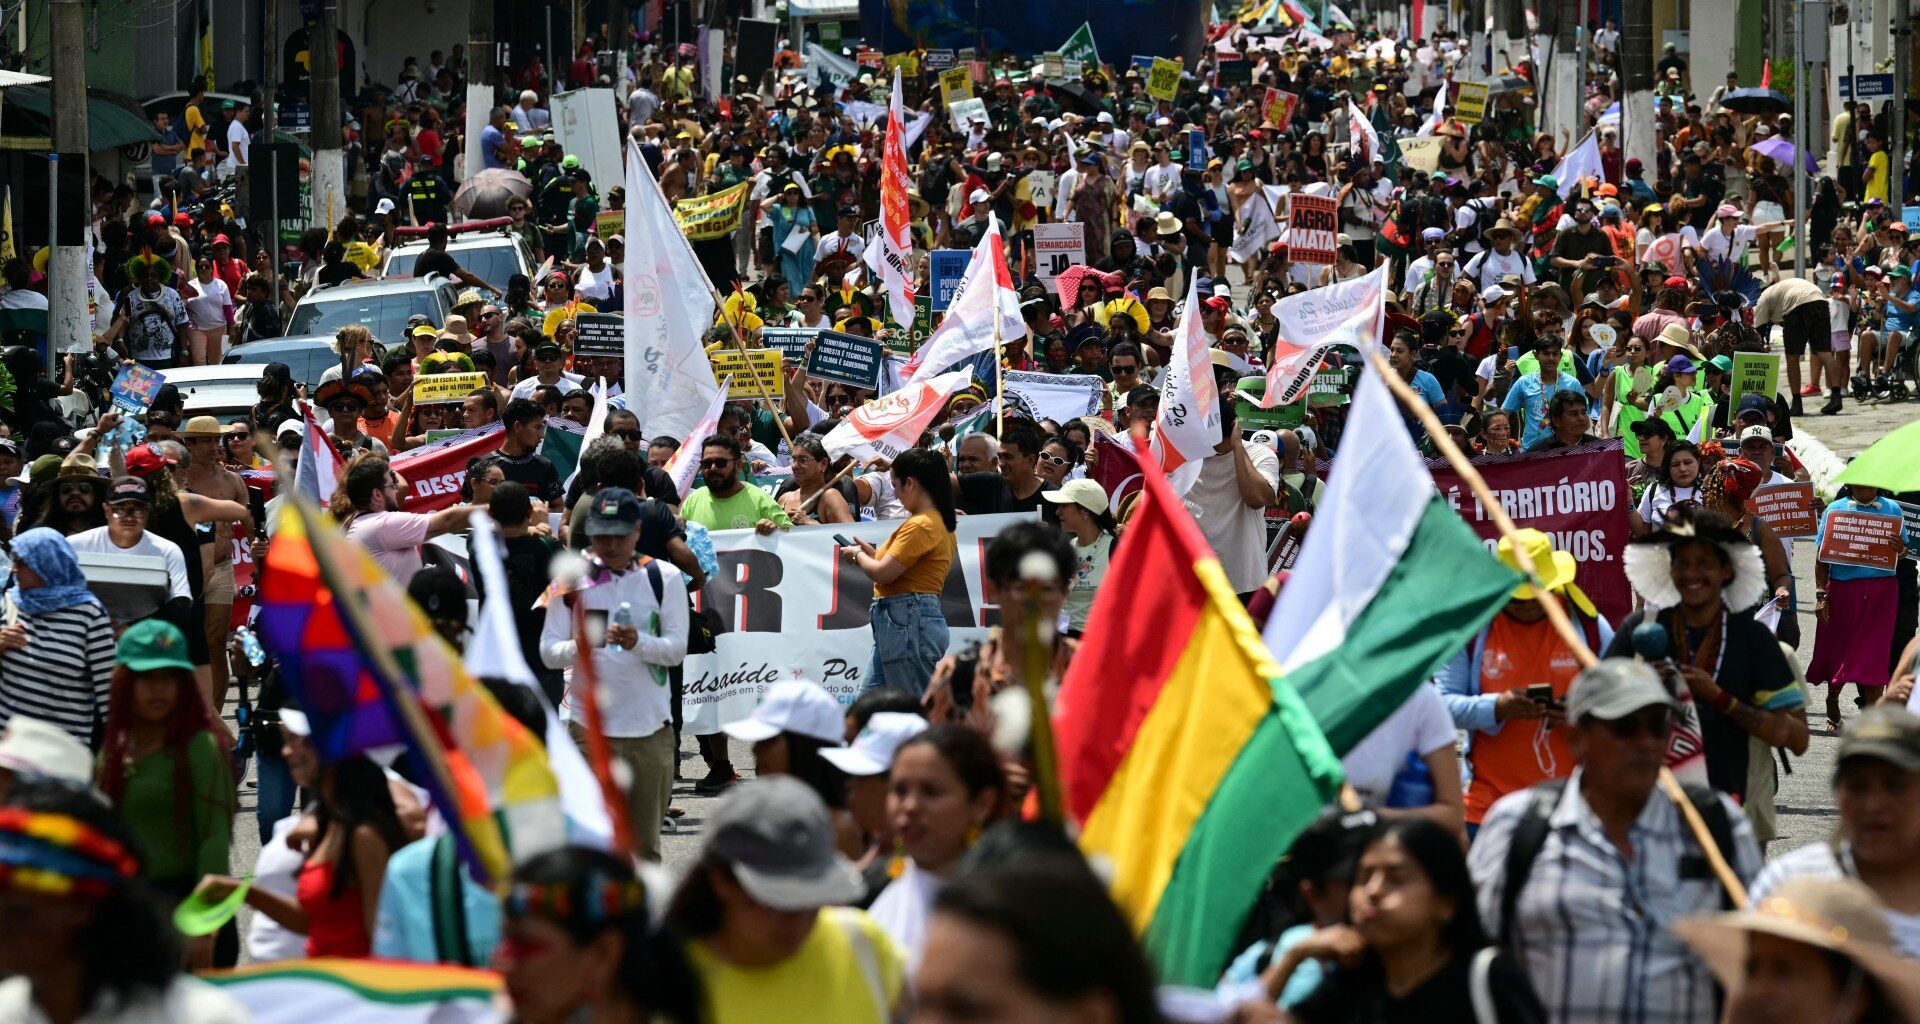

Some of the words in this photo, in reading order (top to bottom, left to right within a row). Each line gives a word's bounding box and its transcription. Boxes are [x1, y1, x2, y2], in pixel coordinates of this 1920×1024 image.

[1292, 208, 1335, 231] AGRO
[600, 222, 622, 231] poder
[1036, 241, 1082, 249] DEMARCAÇÃO
[1290, 228, 1336, 251] MATA
[941, 290, 950, 301] DE
[824, 338, 849, 349] TERRITÓRIO
[818, 347, 840, 357] FLORESTA
[823, 355, 837, 365] CLIMA
[1281, 367, 1311, 402] direitos
[1742, 379, 1755, 390] NÃO
[1756, 380, 1765, 390] HÁ
[1752, 427, 1762, 435] NY
[415, 470, 468, 497] DEST
[1755, 493, 1773, 504] MARCO
[1774, 490, 1803, 500] TEMPORAL
[1758, 502, 1779, 513] DESTRÓI
[1780, 500, 1800, 510] POVOS.
[1792, 510, 1811, 518] CLIMA.
[1834, 516, 1858, 526] EDUCAÇÃO
[1867, 519, 1882, 528] NASCE
[1883, 521, 1893, 529] DOS
[1833, 524, 1860, 534] TERRITÓRIOS
[1861, 526, 1865, 534] É
[1864, 526, 1885, 537] POLÍTICA
[1833, 532, 1850, 541] FUTURO
[1854, 534, 1879, 545] SOBERANIA
[682, 691, 737, 705] Trabalhadores
